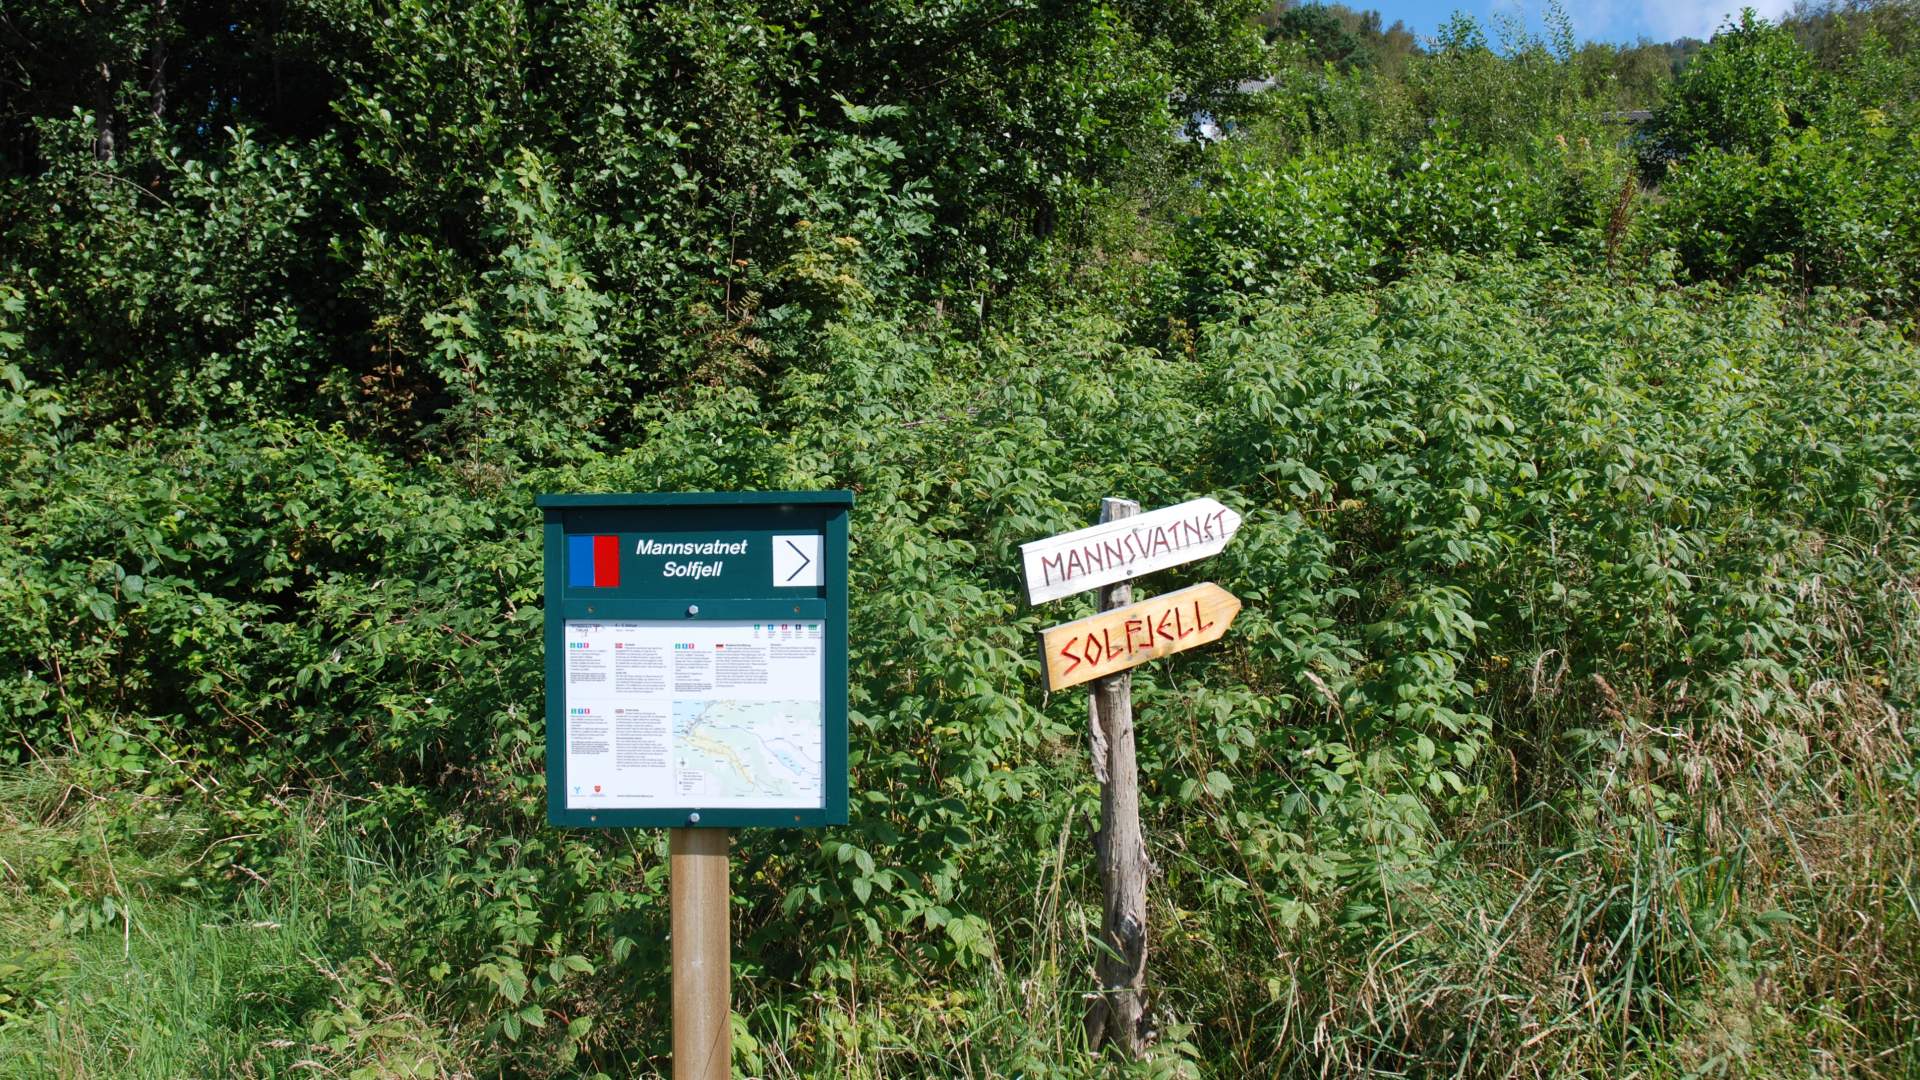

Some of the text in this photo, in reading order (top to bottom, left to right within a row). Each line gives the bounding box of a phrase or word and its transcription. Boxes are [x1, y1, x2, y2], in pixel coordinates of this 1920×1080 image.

[636, 539, 748, 555] Mannsvatnet
[663, 561, 723, 580] Solfjell
[1041, 509, 1227, 587] MANNSVATNET
[1060, 601, 1214, 677] SOLFJELL
